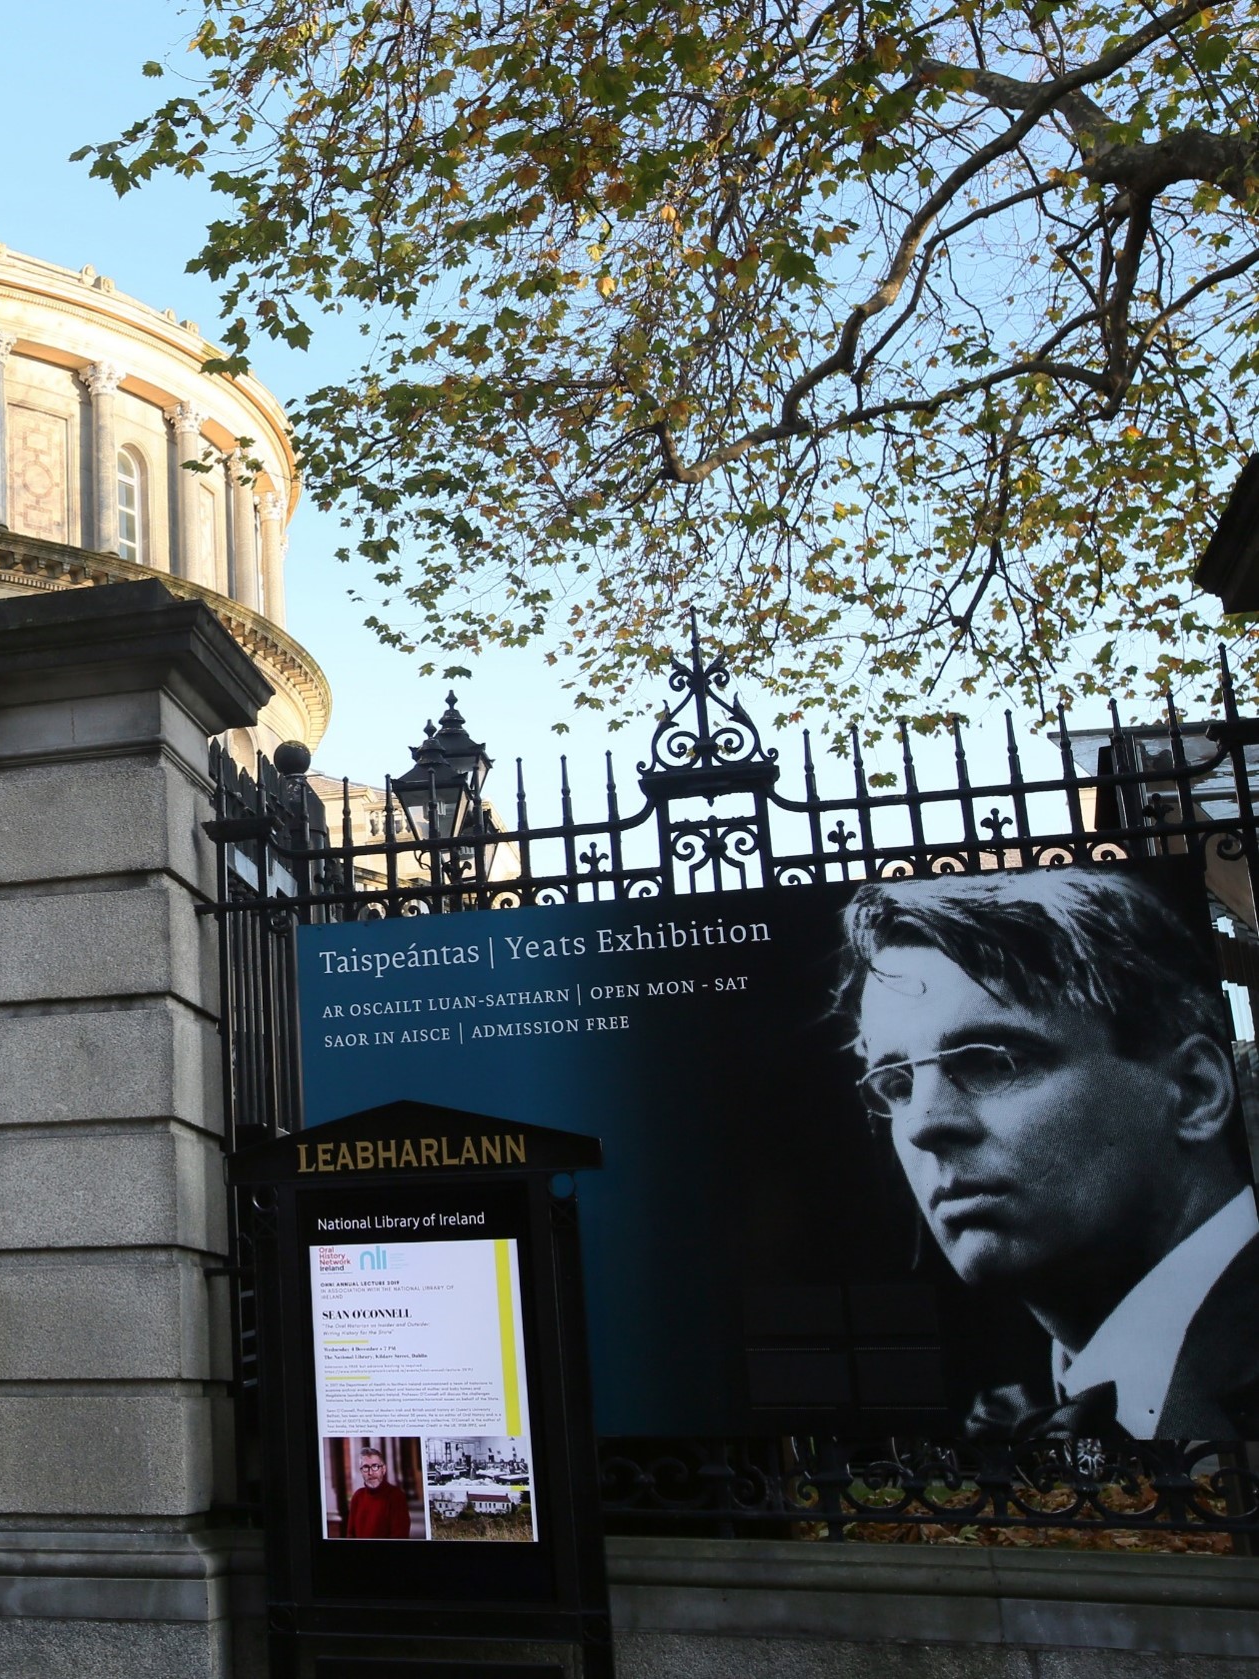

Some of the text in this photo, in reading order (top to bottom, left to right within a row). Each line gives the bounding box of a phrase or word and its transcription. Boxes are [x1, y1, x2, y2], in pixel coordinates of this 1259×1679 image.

[318, 918, 771, 978] Taispeántas Yeats Exhibition
[322, 1004, 345, 1019] AR
[349, 999, 423, 1017] OSCAILT
[427, 988, 570, 1011] LUAN-SATHARN
[590, 983, 640, 1000] OPEN
[647, 980, 694, 996] MON
[714, 976, 748, 992] SAT
[324, 1015, 630, 1048] SAOR IN AISCE ADMISSION FREE
[296, 1134, 526, 1173] LEABHARLANN
[317, 1211, 485, 1231] National Library of Ireland
[360, 1246, 387, 1270] nli
[322, 1309, 412, 1320] SEAN O'CONNELL
